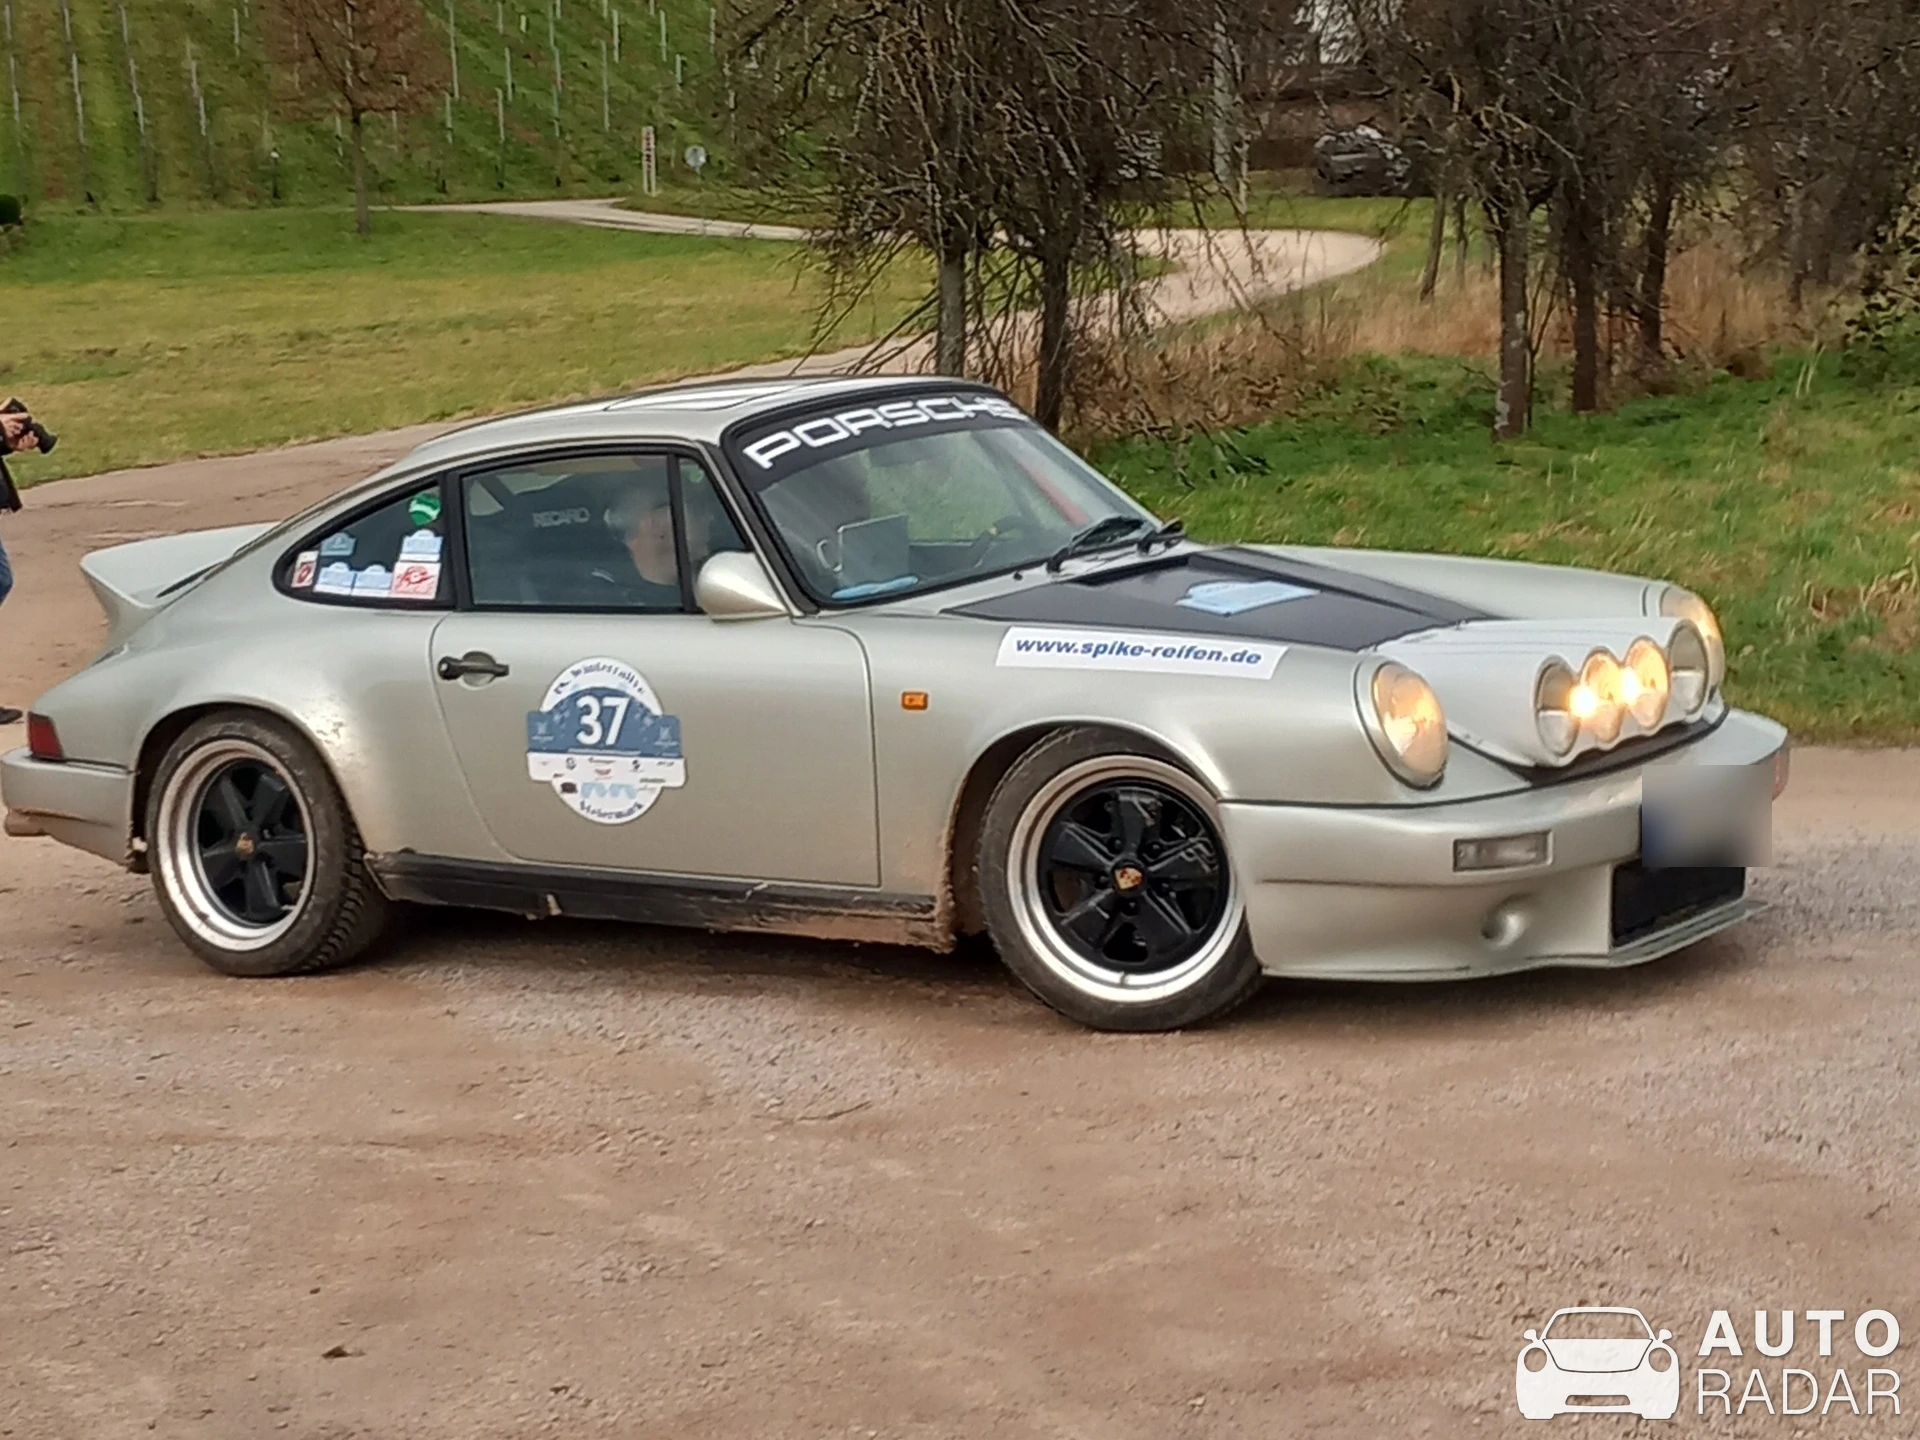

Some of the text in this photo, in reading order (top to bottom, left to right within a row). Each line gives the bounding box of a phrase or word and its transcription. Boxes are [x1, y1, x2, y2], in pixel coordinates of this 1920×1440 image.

[743, 397, 1028, 469] PORSCHE
[1015, 639, 1262, 665] www.spike-reifen.de
[576, 695, 631, 745] 37
